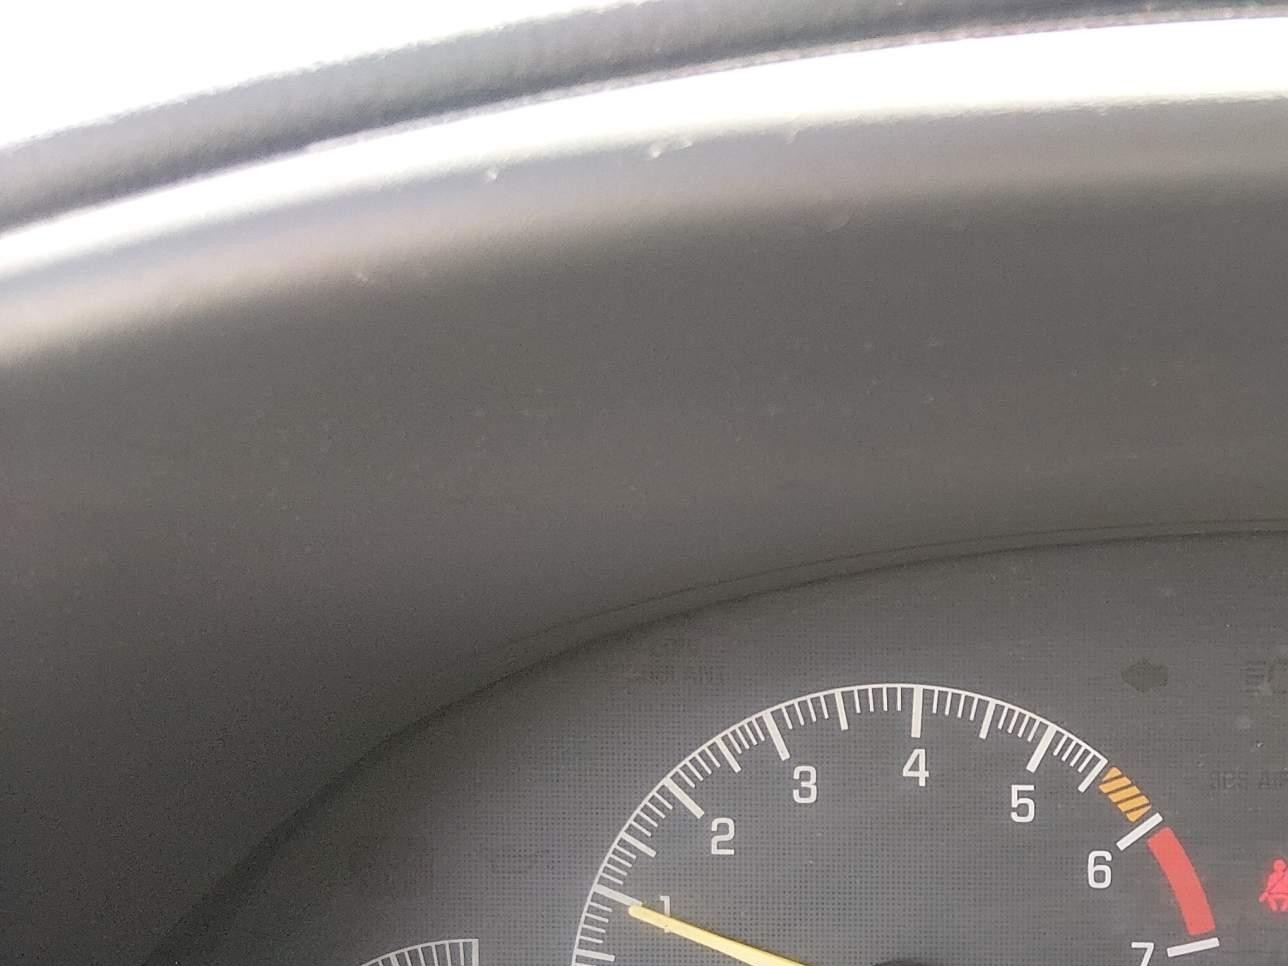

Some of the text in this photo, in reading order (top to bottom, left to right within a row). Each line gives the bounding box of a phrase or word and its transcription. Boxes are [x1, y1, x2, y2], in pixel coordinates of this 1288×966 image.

[792, 765, 817, 804] 3
[902, 748, 930, 787] 4
[1010, 784, 1035, 823] 5
[710, 817, 735, 855] 2
[1087, 850, 1112, 889] 6
